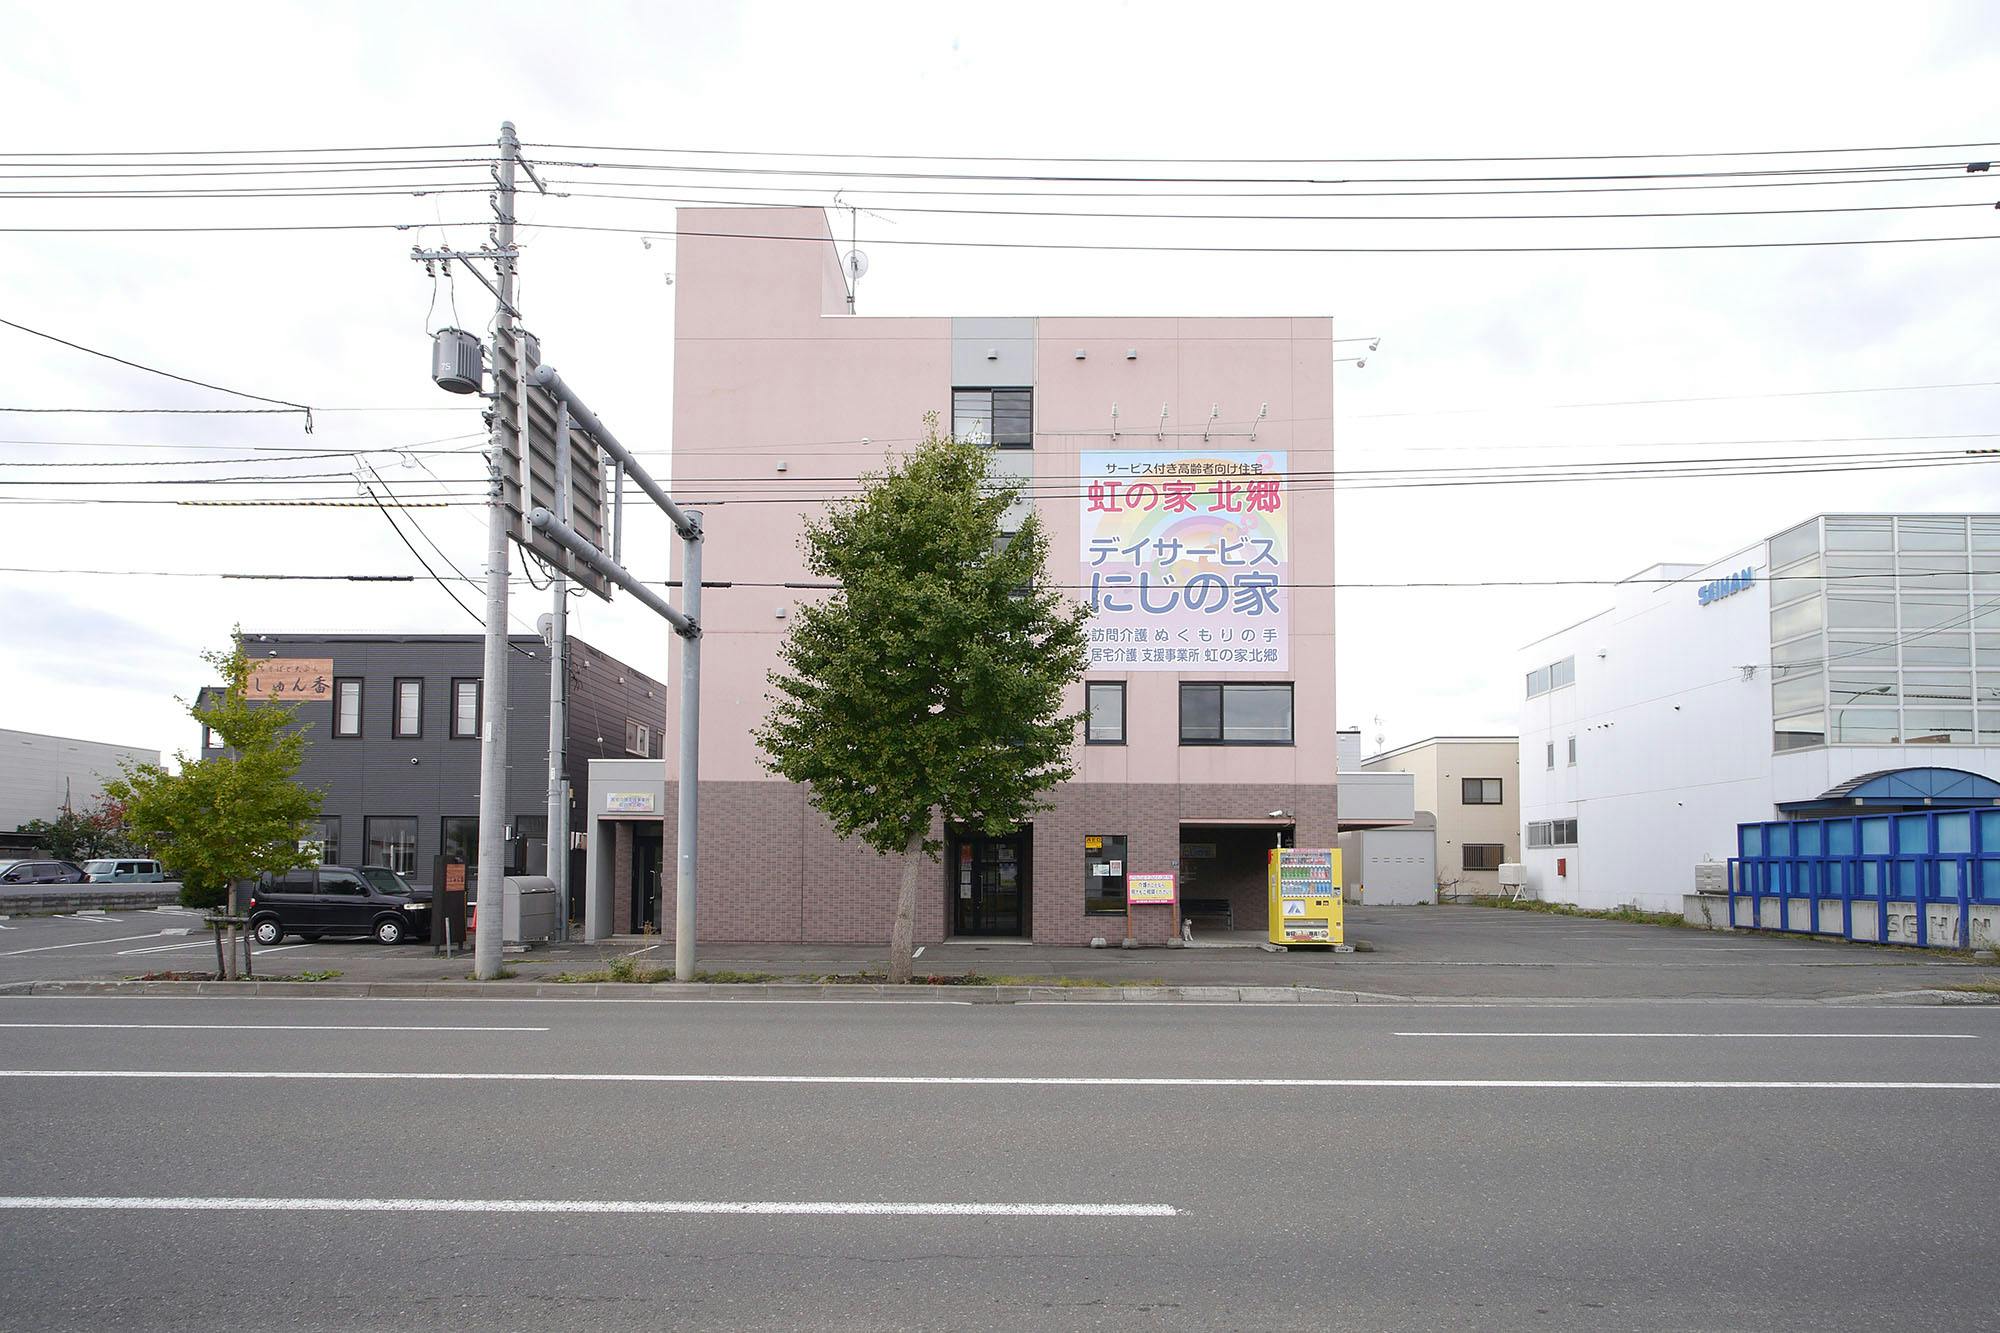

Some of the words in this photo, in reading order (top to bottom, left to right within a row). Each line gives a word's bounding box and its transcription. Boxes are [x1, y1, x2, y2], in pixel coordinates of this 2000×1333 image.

[1106, 463, 1264, 475] サービス付き高齢者向け住宅
[1087, 480, 1197, 513] 虹の家
[1207, 479, 1281, 513] 北郷
[1089, 537, 1279, 566] デイサービス
[1090, 571, 1280, 616] にじの家
[1091, 628, 1148, 643] 訪問介護
[1154, 628, 1278, 643] ぬくもりの手
[1090, 648, 1138, 663] 居宅介護
[1142, 648, 1200, 663] 支援事業所
[1204, 648, 1278, 663] 虹の家北郷
[1887, 913, 1992, 943] SEHN
